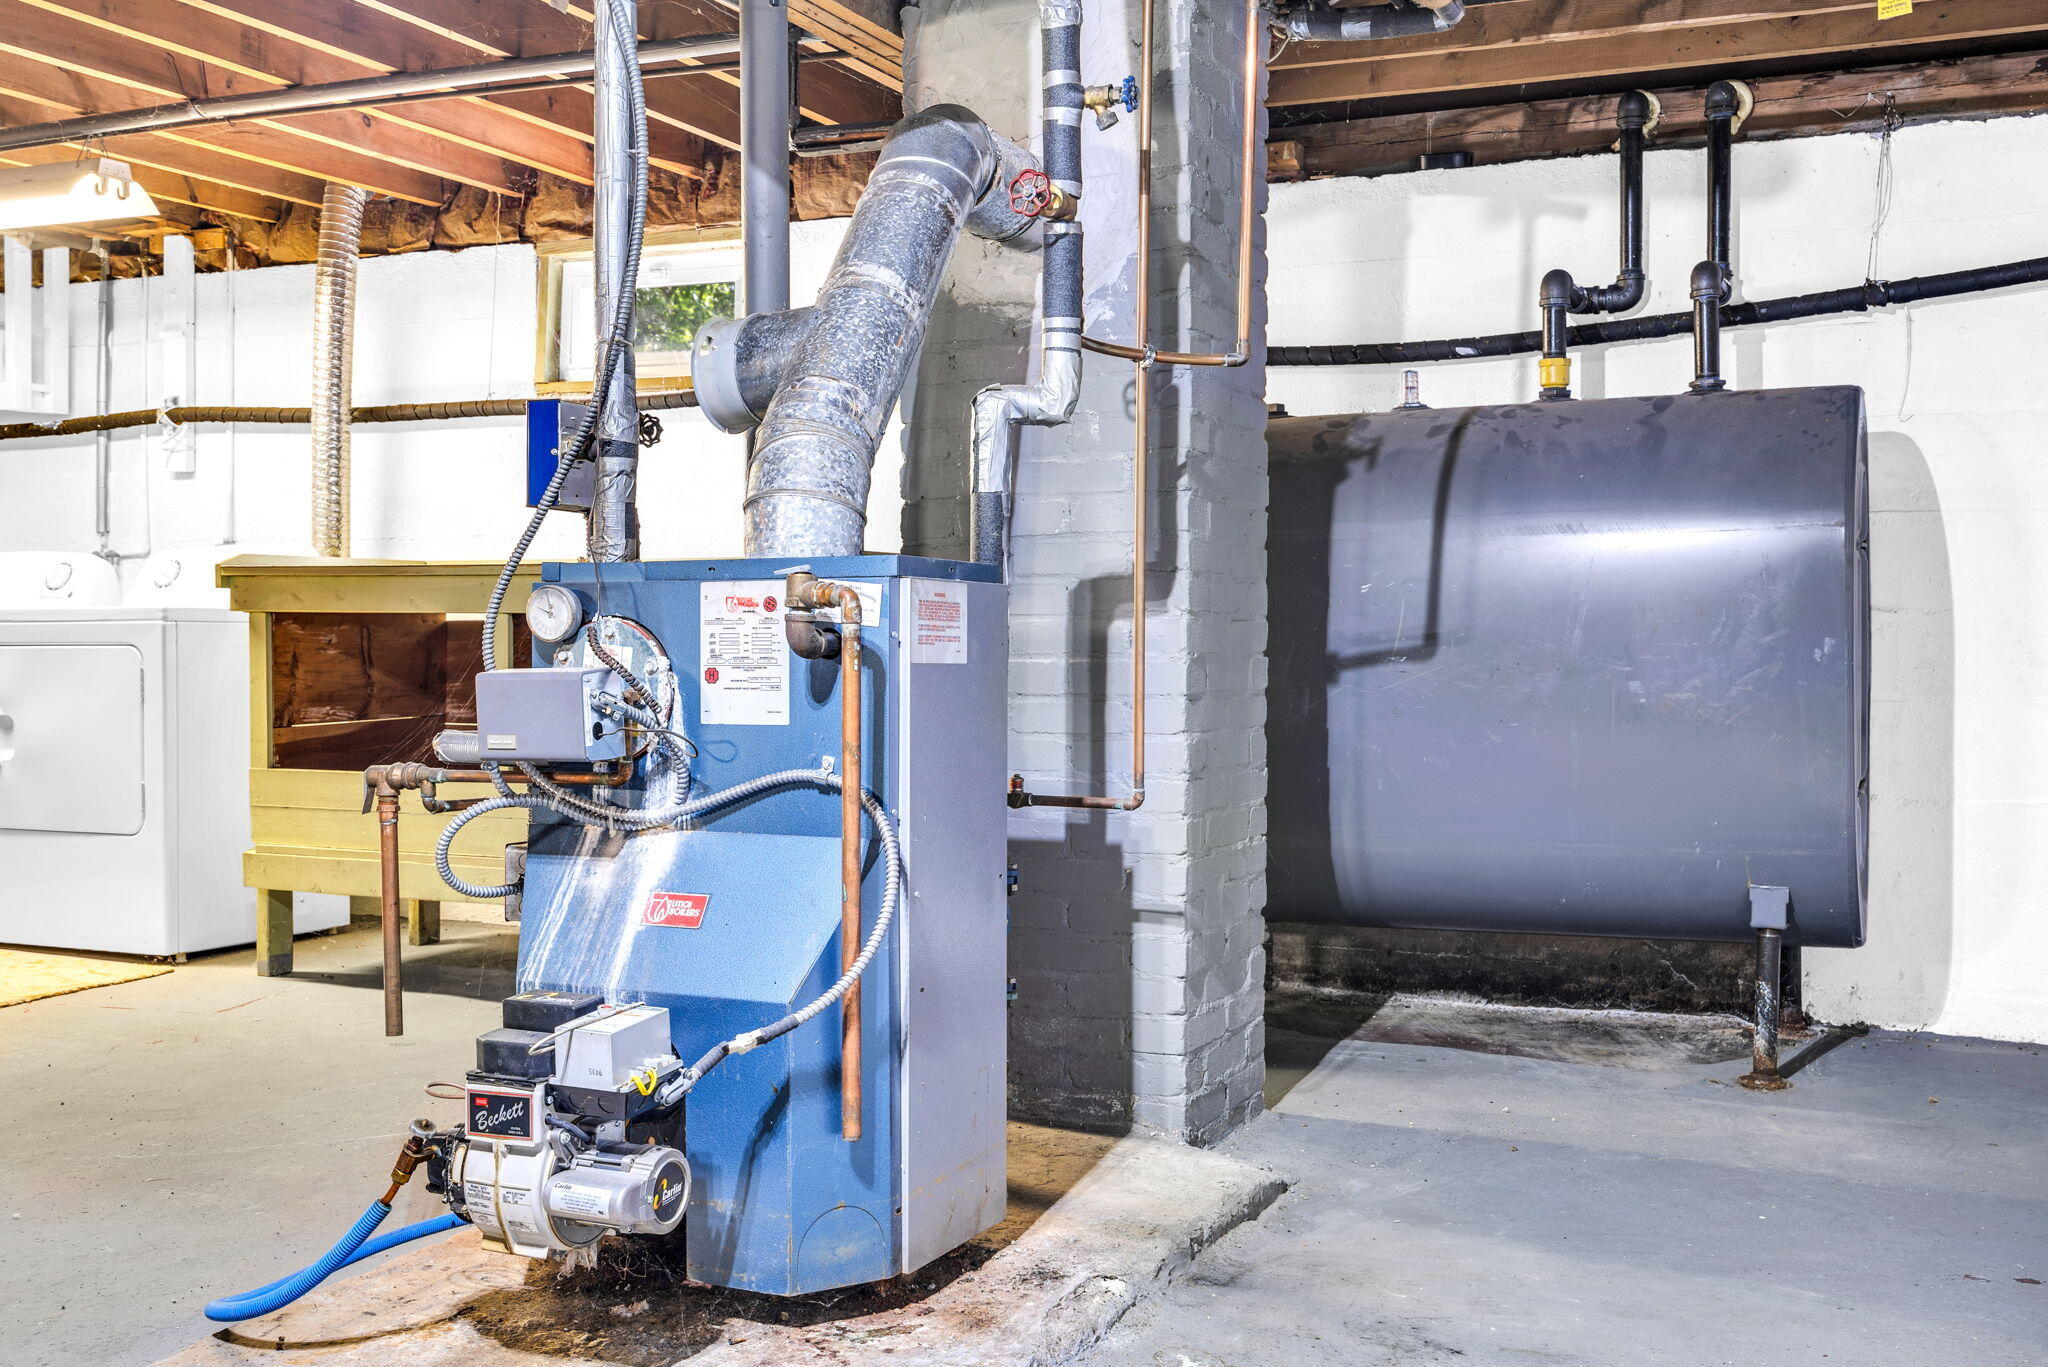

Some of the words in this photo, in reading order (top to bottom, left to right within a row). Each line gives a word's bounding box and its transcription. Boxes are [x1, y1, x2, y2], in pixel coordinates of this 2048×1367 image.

[669, 908, 701, 917] BOILERS
[475, 1100, 524, 1131] Beckett
[662, 1181, 682, 1201] Carlin
